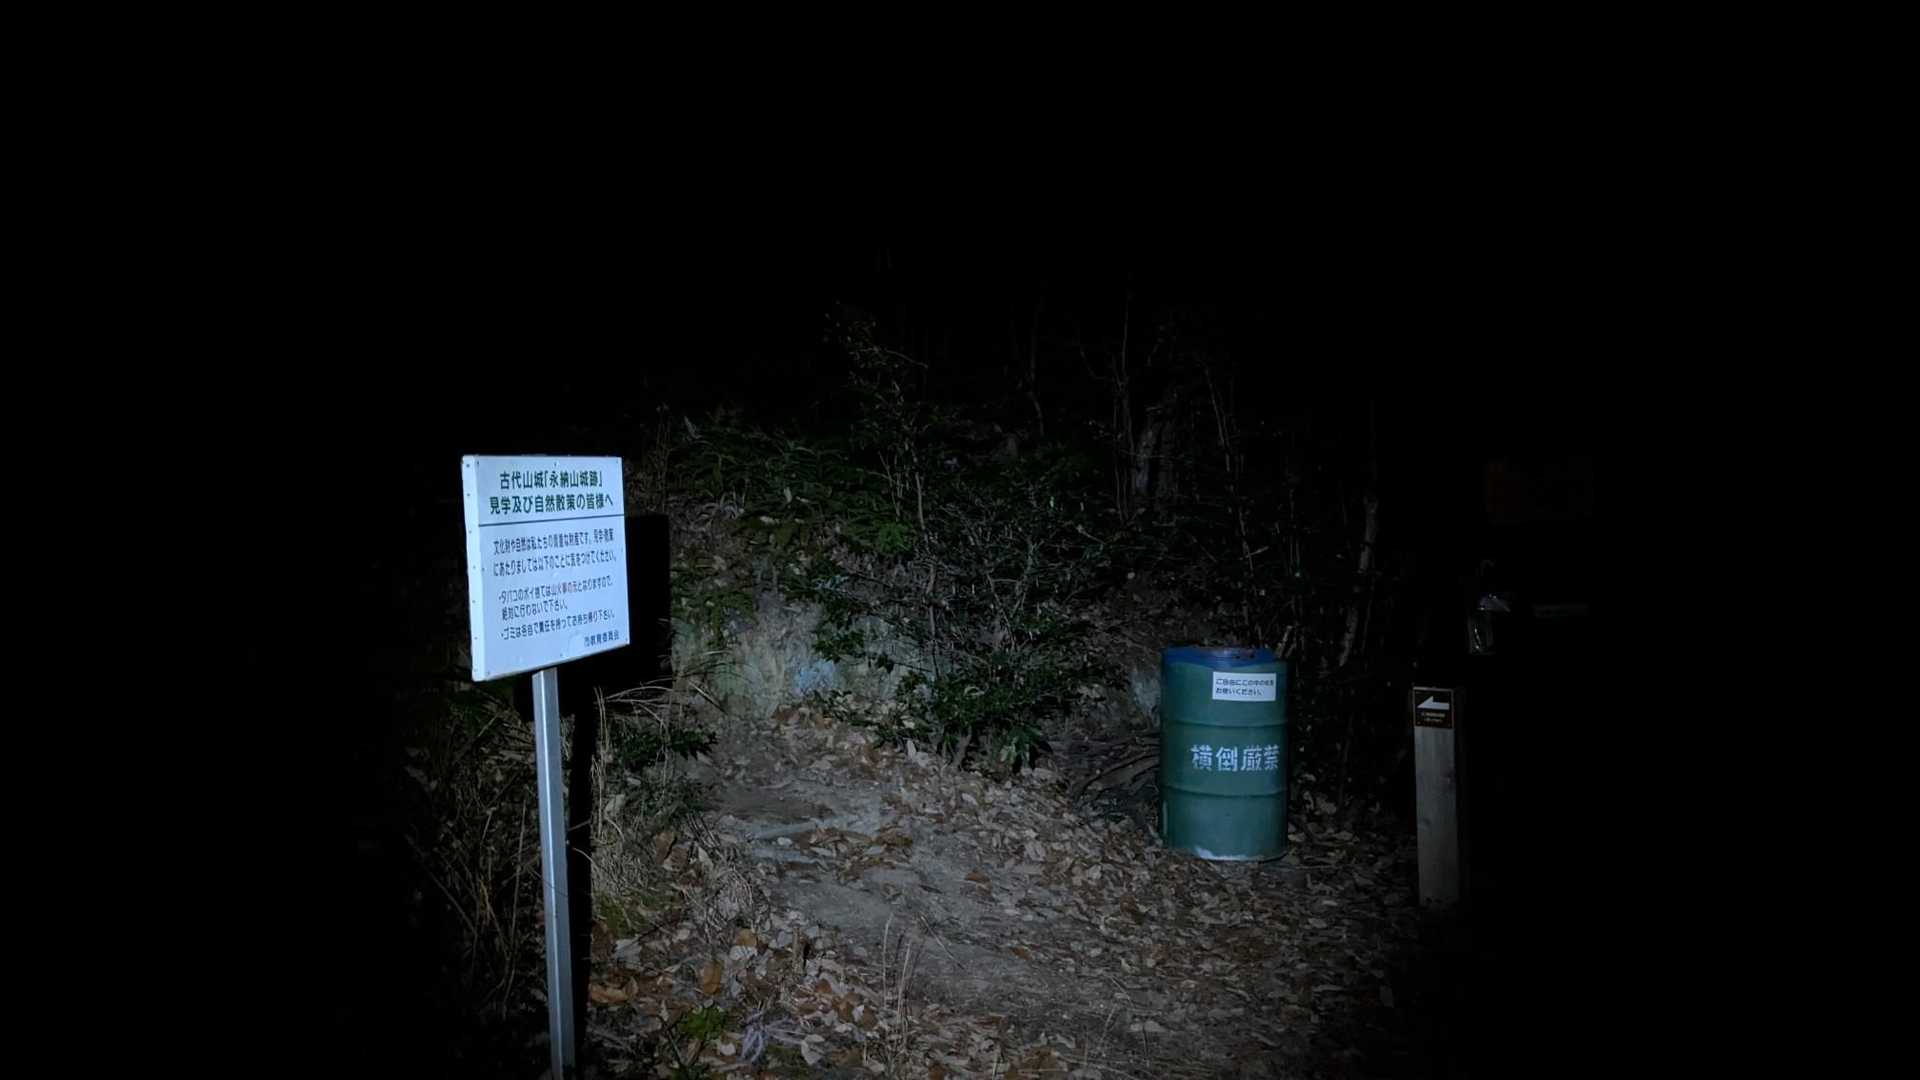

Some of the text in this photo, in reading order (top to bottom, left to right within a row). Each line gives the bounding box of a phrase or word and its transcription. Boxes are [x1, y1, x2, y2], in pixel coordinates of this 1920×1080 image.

[500, 470, 602, 490] 古代山城「永納山城跡」
[489, 494, 613, 515] 見学及び自然散策の皆様へ
[502, 599, 568, 621] 絶対に行わないで下さい。
[1190, 744, 1280, 772] 横倒厳禁
